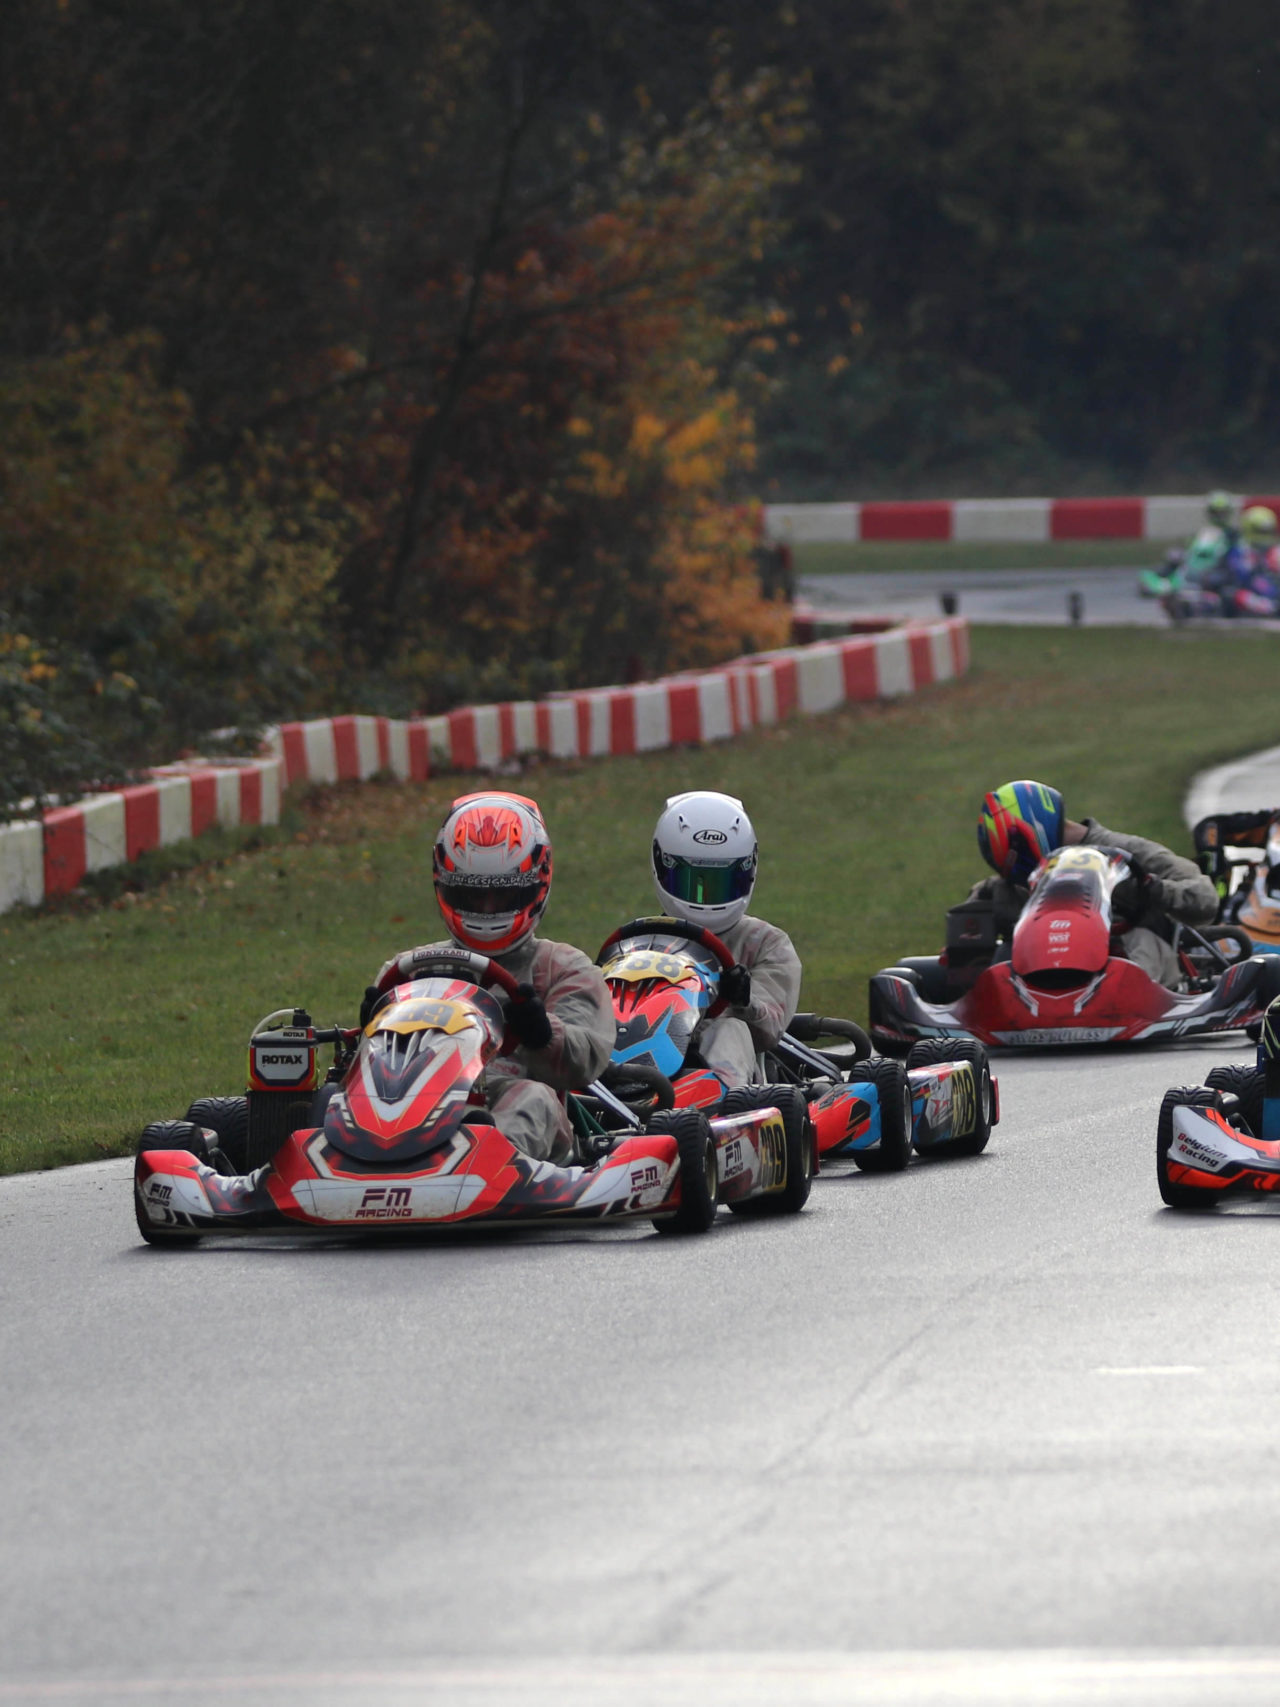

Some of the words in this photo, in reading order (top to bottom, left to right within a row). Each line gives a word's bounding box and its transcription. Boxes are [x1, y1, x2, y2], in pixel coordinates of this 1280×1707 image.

[696, 831, 724, 842] Arai
[262, 1054, 303, 1064] ROTAX
[725, 1139, 743, 1167] FM
[1178, 1133, 1228, 1159] Belgium
[1179, 1144, 1220, 1168] Racing
[631, 1165, 658, 1185] FM
[724, 1161, 744, 1180] RACING
[150, 1182, 173, 1200] FM
[630, 1179, 661, 1193] RACING
[361, 1187, 412, 1207] FM
[354, 1208, 412, 1217] RACING
